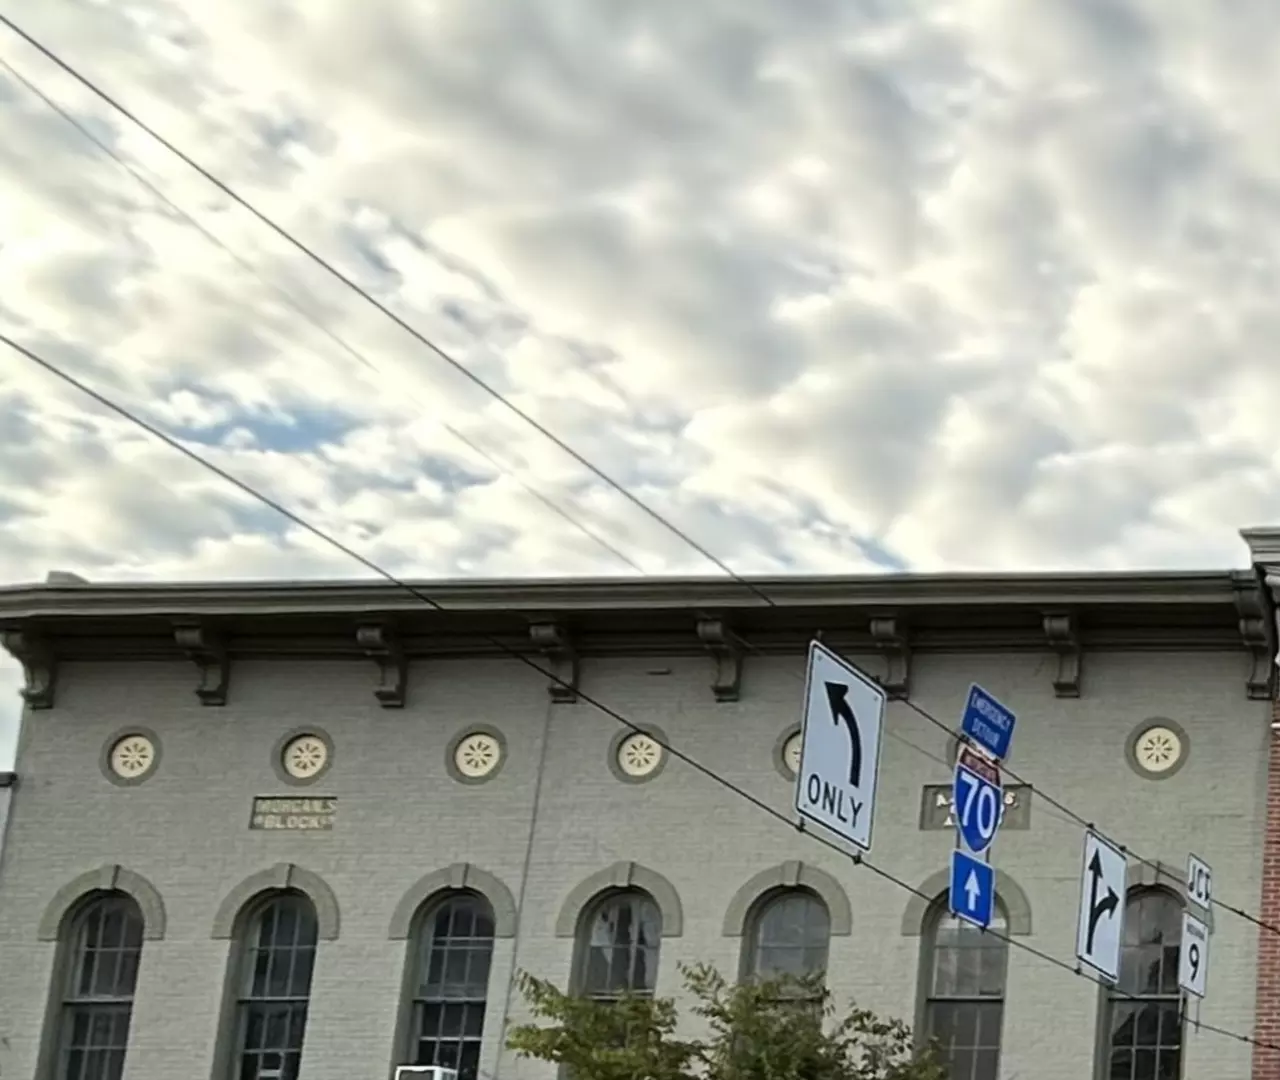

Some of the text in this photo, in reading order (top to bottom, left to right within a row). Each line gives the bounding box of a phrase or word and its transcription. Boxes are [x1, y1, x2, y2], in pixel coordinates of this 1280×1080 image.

[807, 772, 864, 829] ONLY
[961, 771, 997, 839] 70
[1188, 862, 1211, 901] JCT
[1188, 942, 1200, 983] 9
